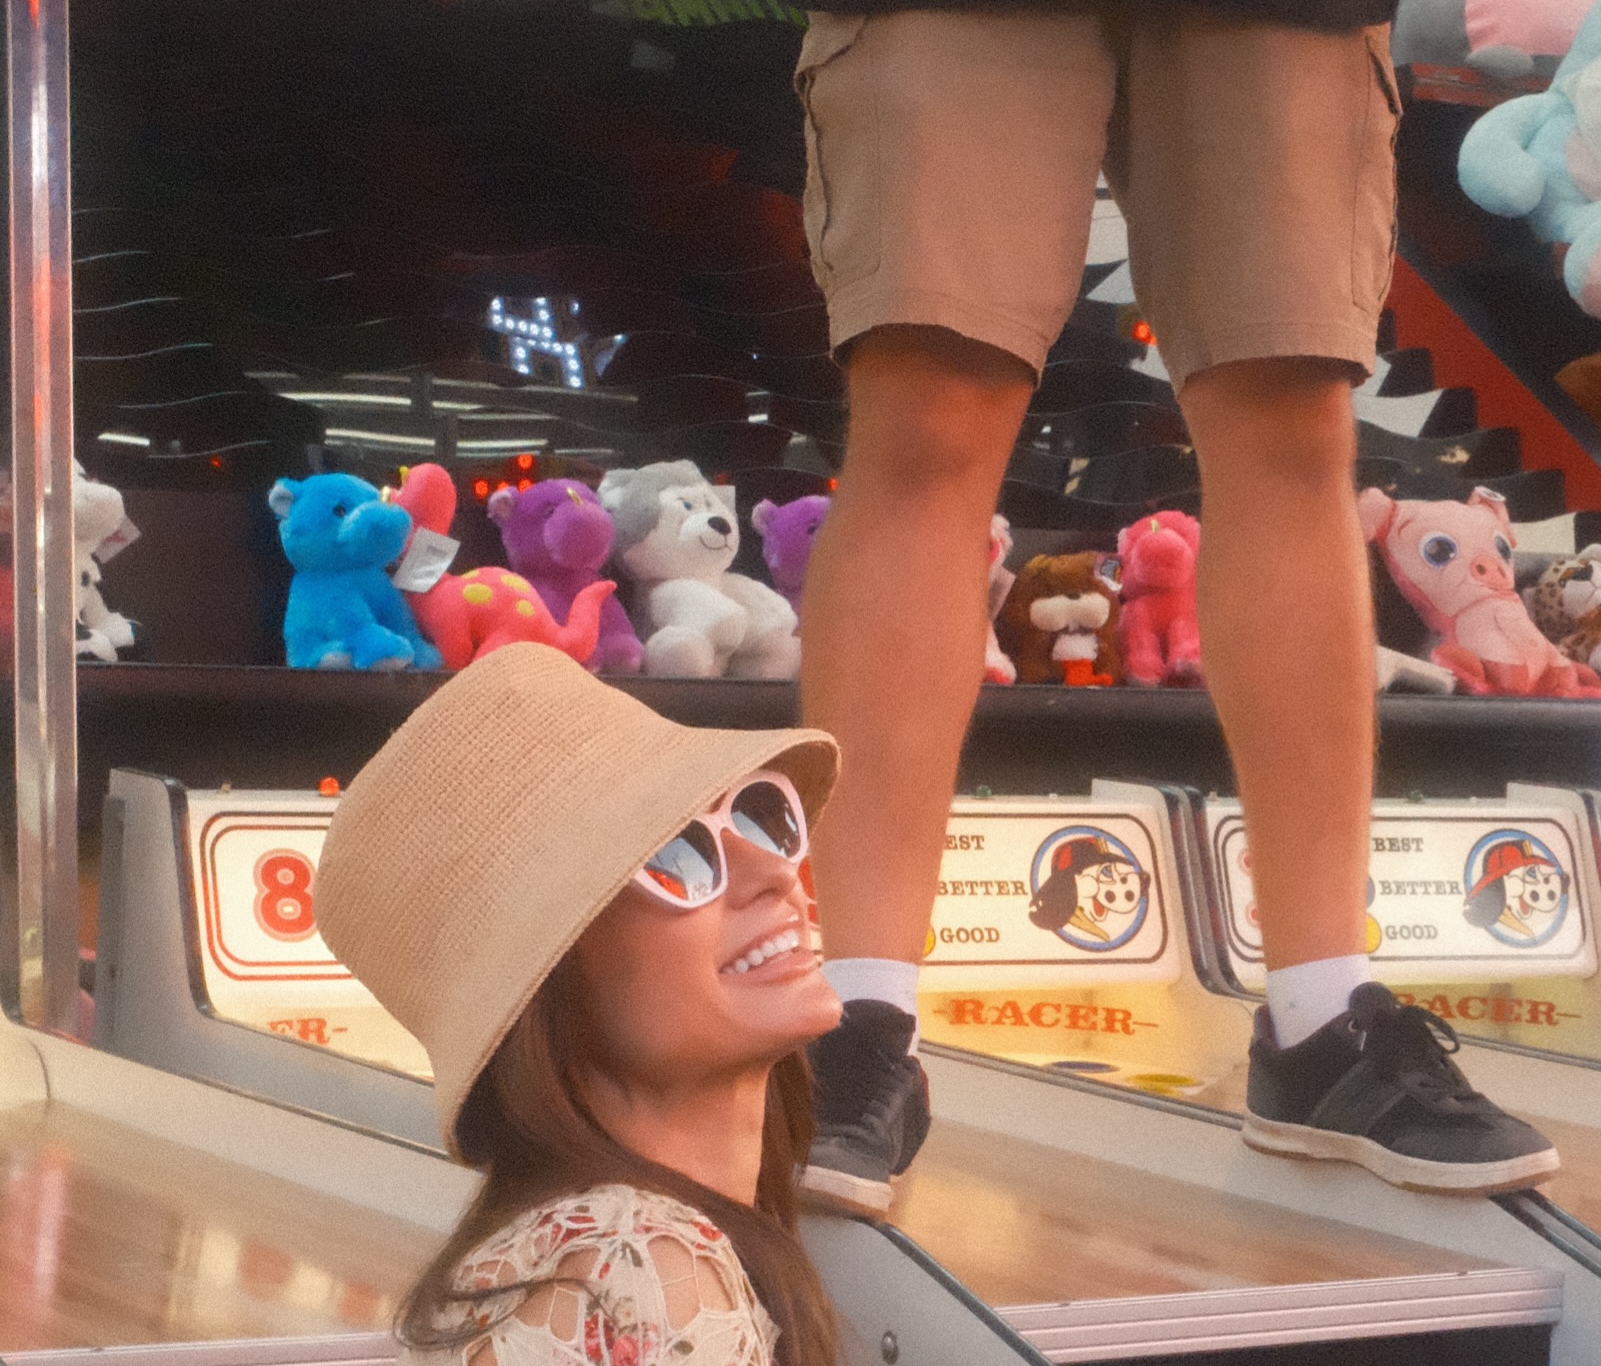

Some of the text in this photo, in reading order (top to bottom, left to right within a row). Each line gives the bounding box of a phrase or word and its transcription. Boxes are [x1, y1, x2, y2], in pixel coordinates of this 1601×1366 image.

[944, 835, 985, 851] EST
[1373, 837, 1424, 853] BEST
[256, 851, 317, 939] 8
[1379, 880, 1463, 896] BETTER
[940, 927, 1001, 944] GOOD
[1385, 924, 1438, 940] GOOD
